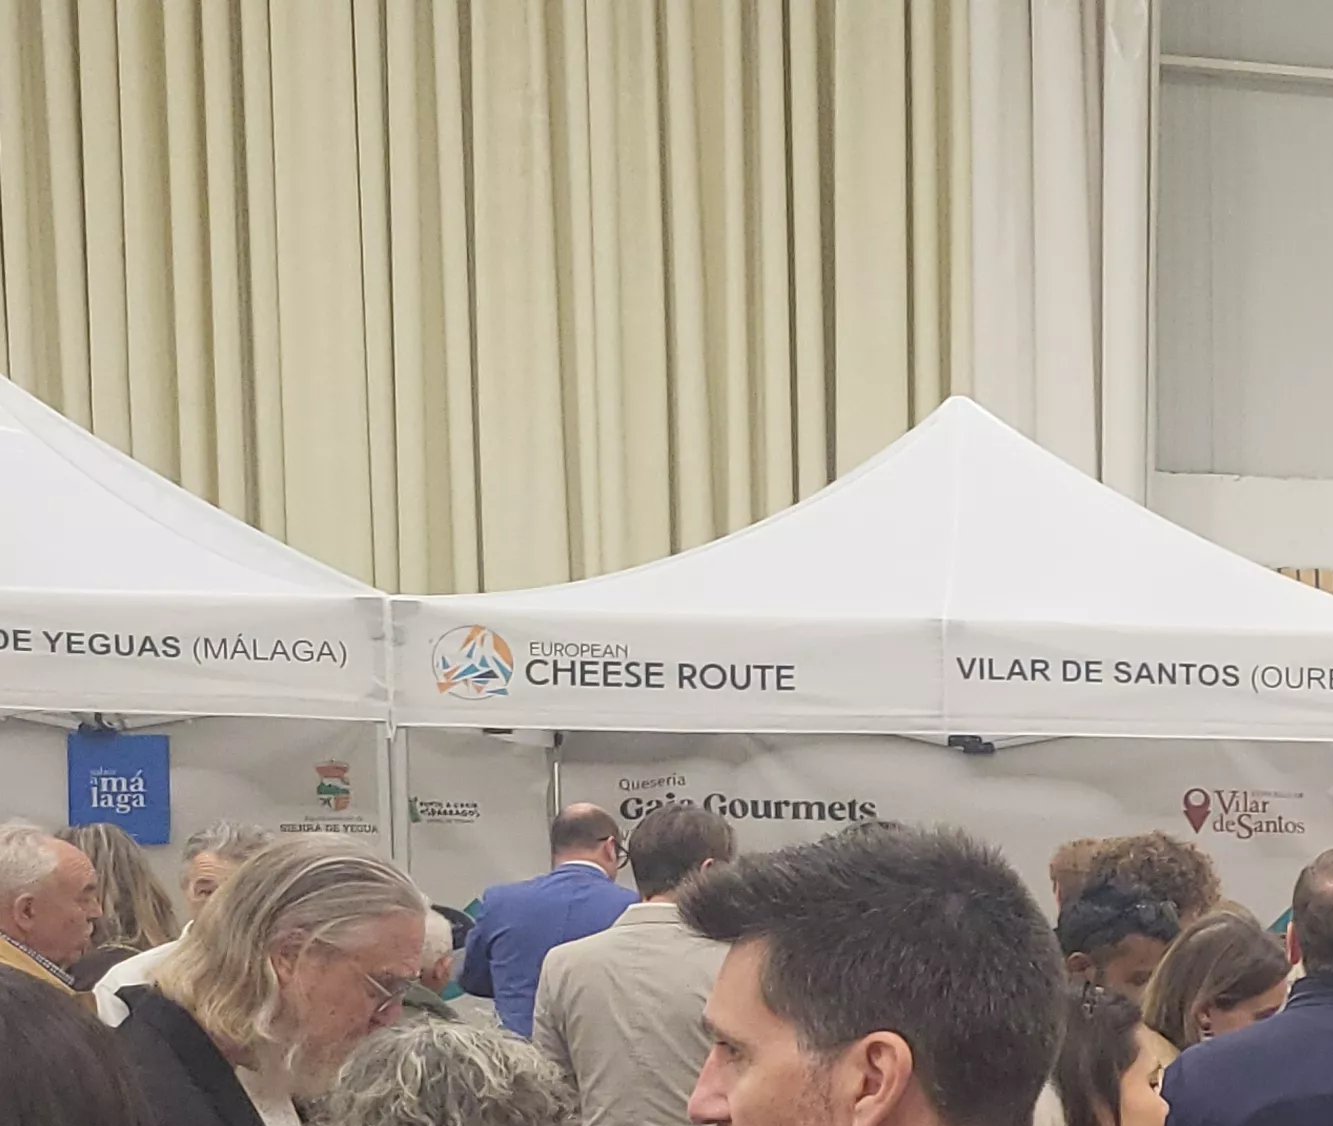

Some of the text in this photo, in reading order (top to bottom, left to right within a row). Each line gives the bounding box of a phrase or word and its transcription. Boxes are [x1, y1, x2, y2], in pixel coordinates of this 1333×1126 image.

[43, 630, 182, 658] YEGUAS
[192, 633, 348, 669] (MÁLAGA)
[529, 641, 629, 658] EUROPEAN
[525, 659, 796, 691] CHEESE ROUTE
[956, 657, 1051, 682] VILAR
[1062, 660, 1103, 684] DE
[1114, 661, 1241, 687] SANTOS
[91, 786, 146, 814] laga
[703, 793, 877, 822] Gourmets
[1213, 790, 1270, 815] Vilar
